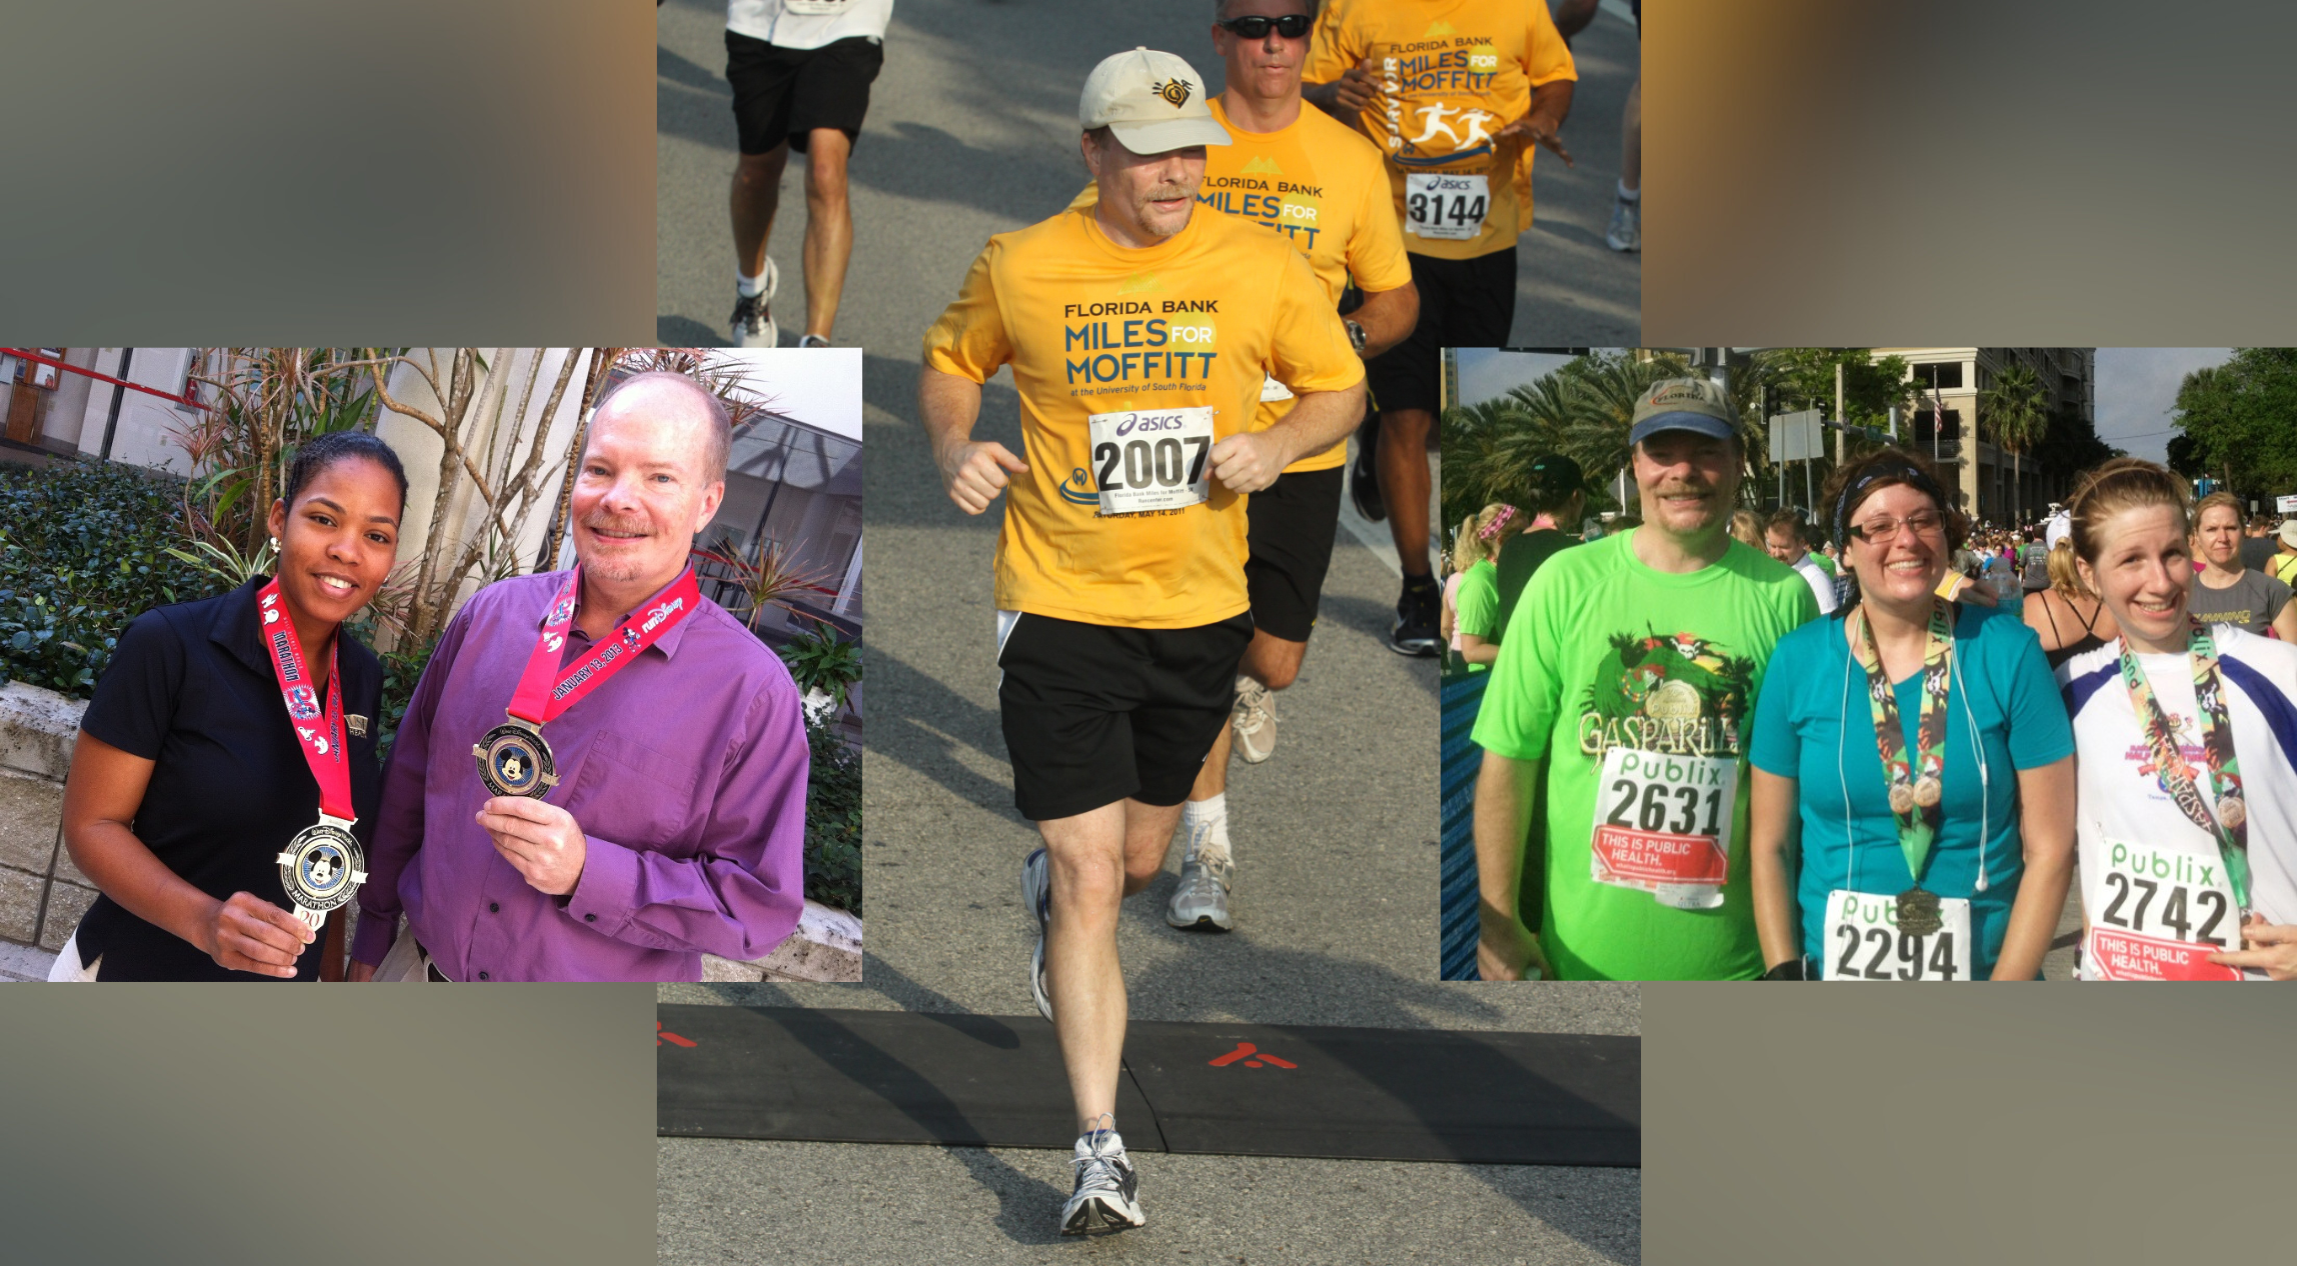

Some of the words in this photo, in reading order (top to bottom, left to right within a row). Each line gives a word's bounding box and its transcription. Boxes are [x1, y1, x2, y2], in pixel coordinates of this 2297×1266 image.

[1390, 40, 1449, 54] FLORIDA
[1455, 37, 1493, 47] BANK
[1399, 50, 1469, 76] MILES
[1470, 55, 1498, 67] FOR
[1400, 70, 1498, 93] MOFFITT
[1277, 182, 1323, 198] BANK
[1440, 180, 1471, 190] asics
[1196, 192, 1281, 219] MILES
[1283, 204, 1318, 221] FOR
[1409, 193, 1485, 226] 3144
[1065, 302, 1153, 318] FLORIDA
[1162, 300, 1219, 314] BANK
[1065, 319, 1168, 352] MILES
[1171, 326, 1213, 344] FOR
[1066, 352, 1218, 384] MOFFITT
[1071, 389, 1079, 397] at
[1080, 387, 1094, 396] the
[1096, 384, 1140, 396] University
[1142, 383, 1151, 392] of
[1152, 383, 1177, 391] South
[1179, 383, 1206, 392] Florida
[1138, 415, 1183, 431] asics
[1095, 436, 1211, 491] 2007
[1139, 509, 1155, 518] MAY
[1169, 507, 1185, 516] 2011
[272, 630, 301, 682] MARATHON
[552, 664, 594, 701] JANUARY
[590, 657, 607, 672] 13,
[601, 643, 624, 663] 2013
[1620, 753, 1721, 786] Publix
[1606, 779, 1722, 835] 2631
[1602, 833, 1628, 848] THIS
[1631, 839, 1642, 850] IS
[1646, 841, 1691, 855] PUBLIC
[1612, 849, 1662, 866] HEALTH.
[2112, 843, 2214, 886] Publix
[292, 889, 337, 909] MARATHON
[1842, 896, 1943, 927] Pub
[2103, 872, 2227, 947] 2742
[1836, 924, 1957, 981] 2294
[2100, 937, 2127, 953] THIS
[2130, 942, 2140, 956] IS
[2143, 945, 2189, 964] PUBLIC
[2111, 954, 2162, 975] HEALTH.
